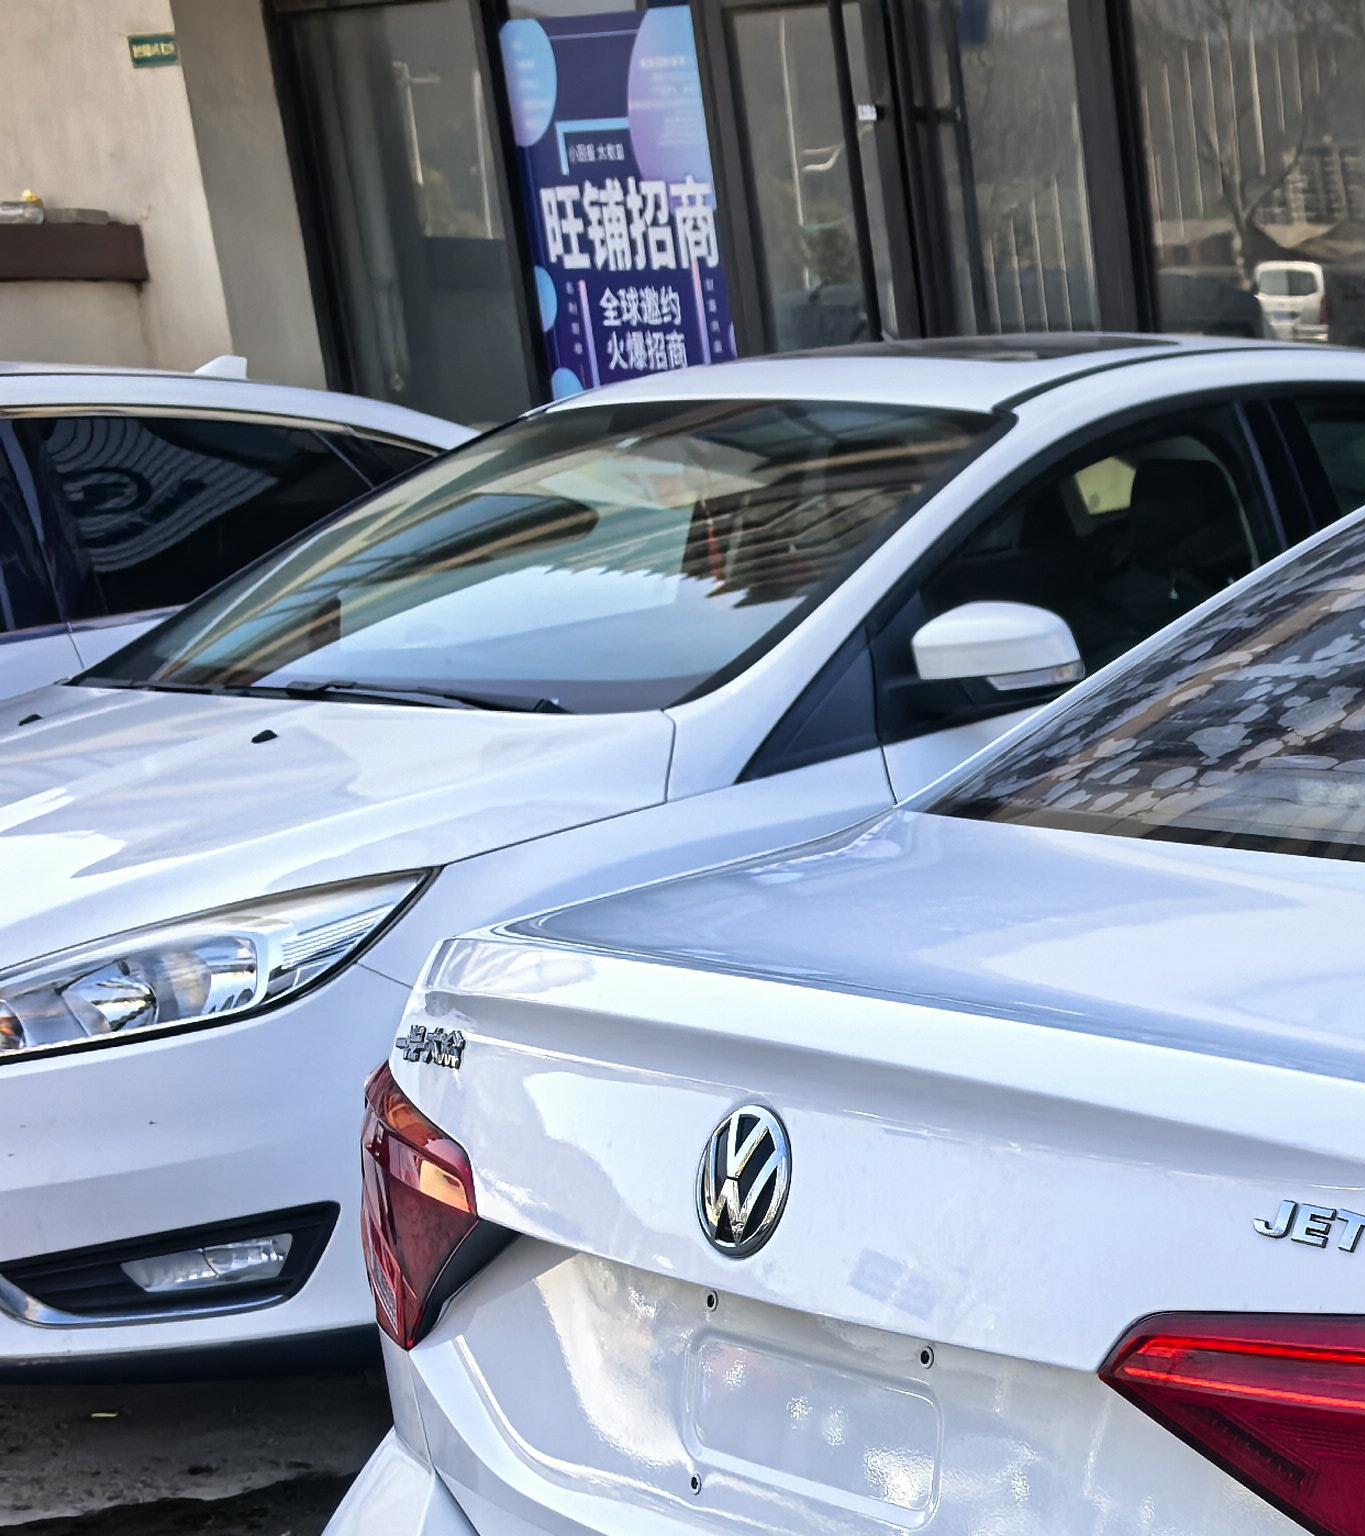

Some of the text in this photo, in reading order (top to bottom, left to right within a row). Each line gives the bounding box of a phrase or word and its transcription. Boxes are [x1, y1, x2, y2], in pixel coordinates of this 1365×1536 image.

[540, 175, 719, 271] 旺铺招商
[600, 285, 681, 326] 全球邀约
[607, 330, 688, 370] 火爆招商
